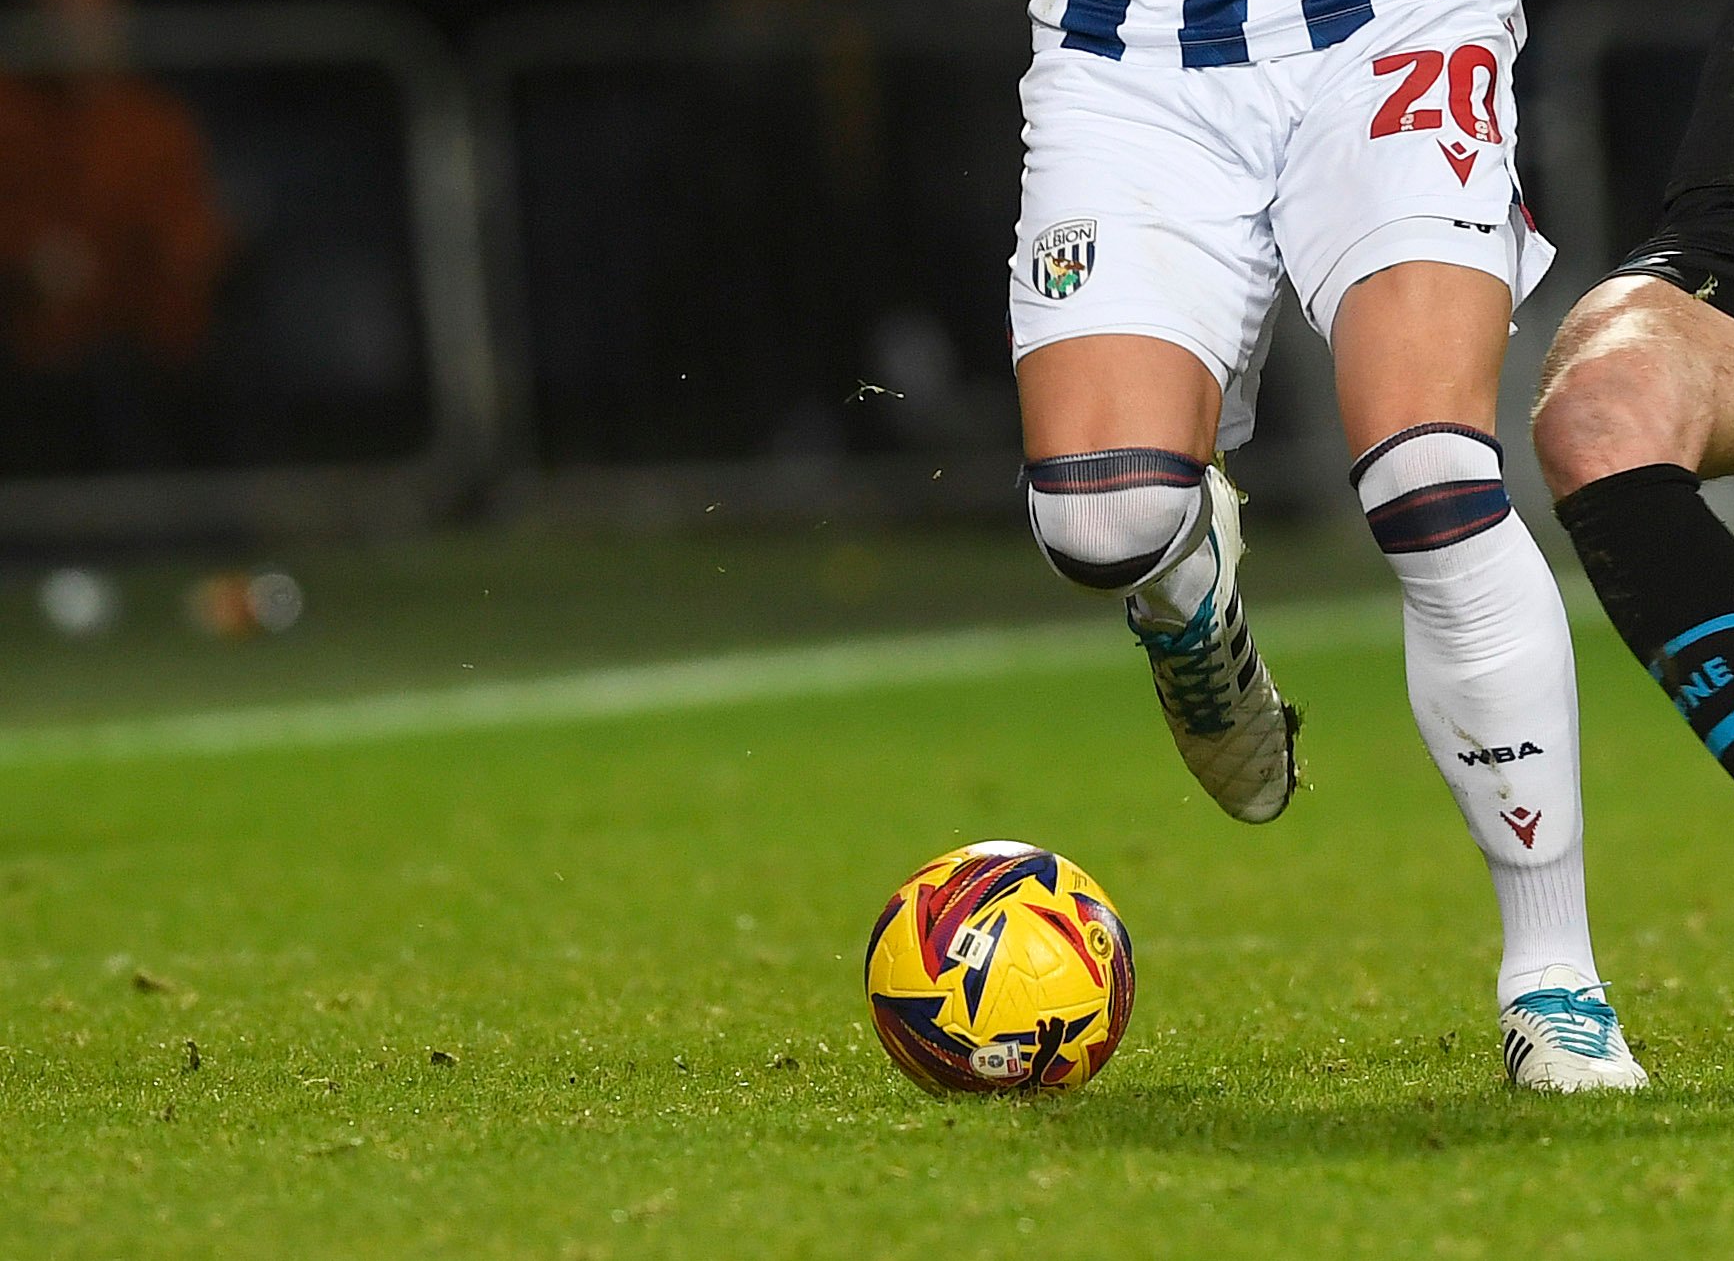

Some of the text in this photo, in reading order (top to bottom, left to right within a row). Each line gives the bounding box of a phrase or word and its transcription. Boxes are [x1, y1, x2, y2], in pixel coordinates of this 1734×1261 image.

[1370, 45, 1503, 144] 20
[1036, 226, 1092, 256] ALBION
[1457, 742, 1544, 767] WBA
